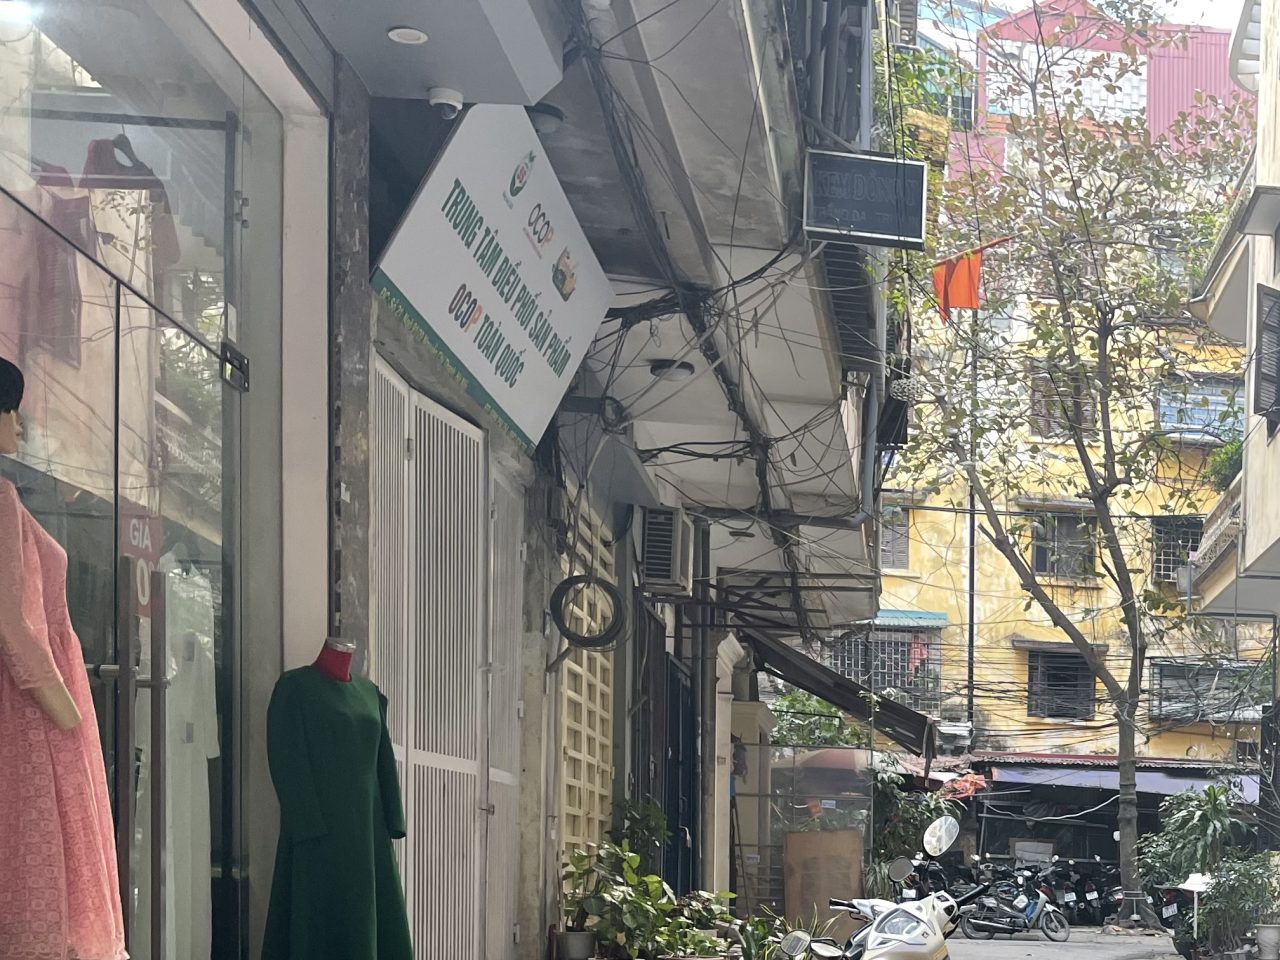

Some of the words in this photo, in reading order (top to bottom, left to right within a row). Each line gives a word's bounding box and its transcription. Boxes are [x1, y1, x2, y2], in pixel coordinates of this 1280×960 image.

[528, 203, 554, 247] OCOP
[441, 177, 483, 249] TRUNG
[473, 226, 503, 278] TÂM
[510, 284, 542, 331] PHỐI
[528, 309, 553, 352] SẢN
[542, 332, 572, 378] PHẨM
[448, 283, 483, 333] OCOP
[473, 313, 505, 364] TOÀN
[495, 344, 526, 389] QUỐC
[130, 518, 152, 552] GIÁ
